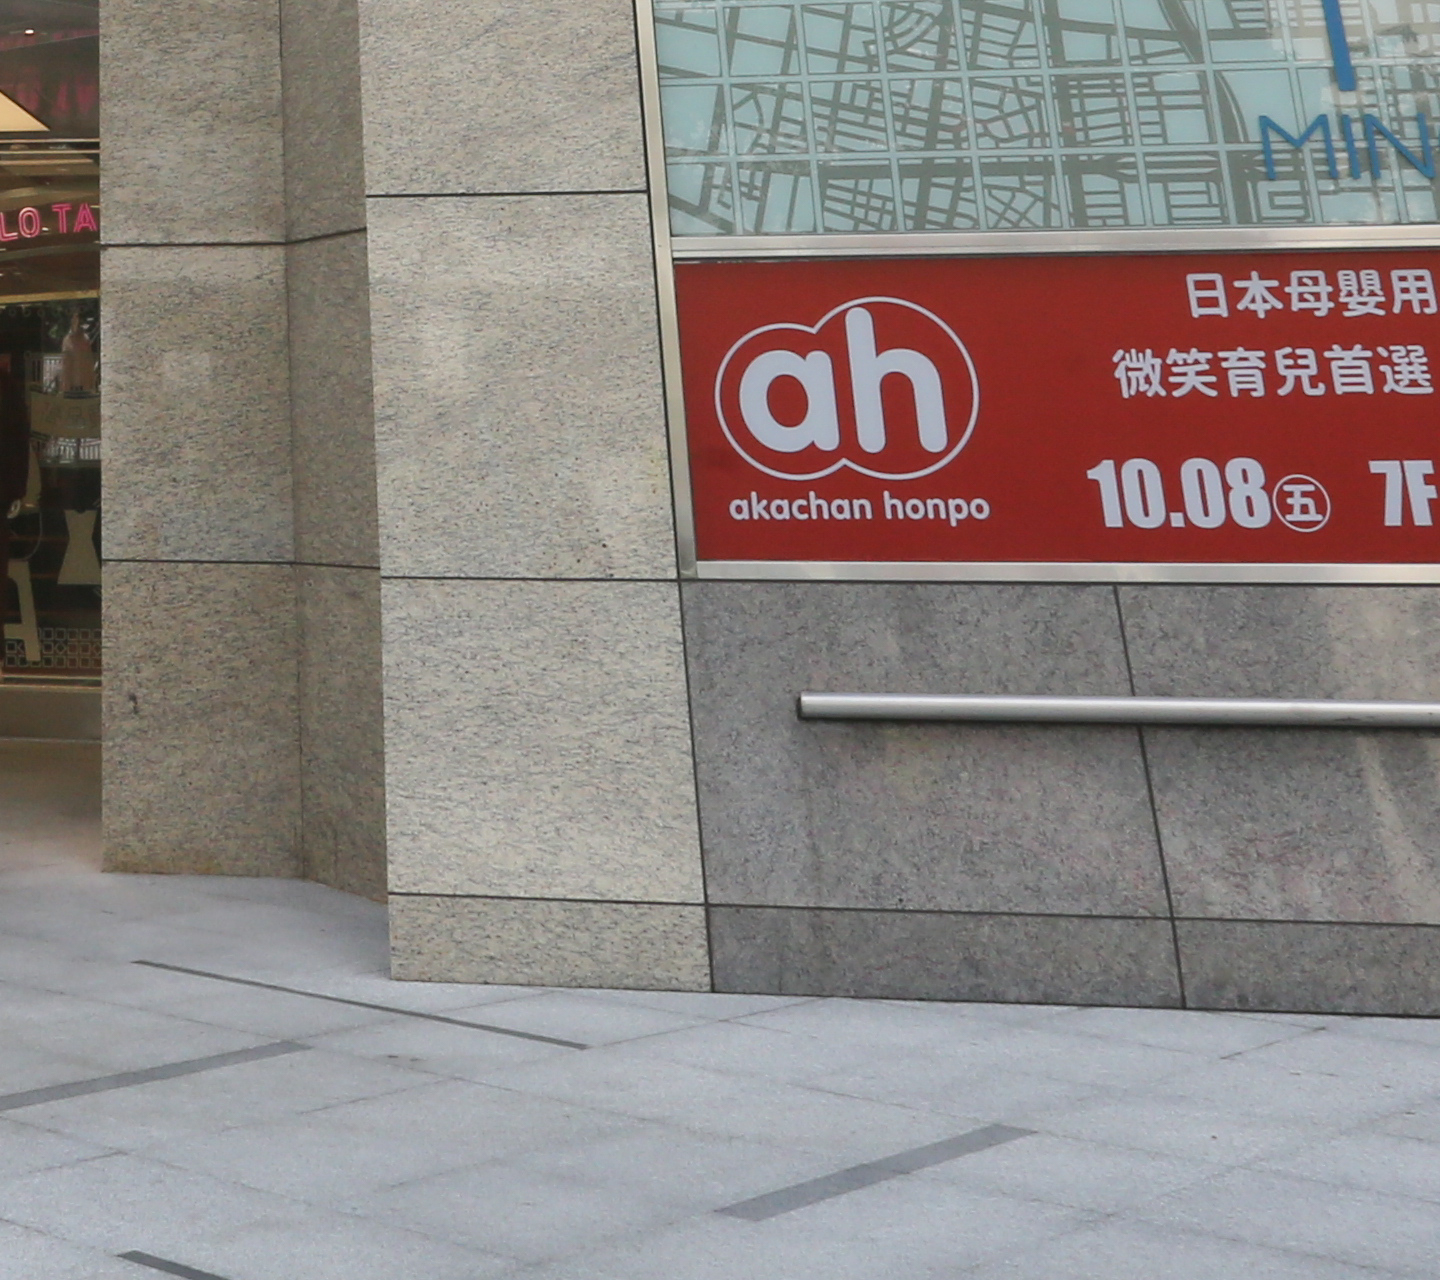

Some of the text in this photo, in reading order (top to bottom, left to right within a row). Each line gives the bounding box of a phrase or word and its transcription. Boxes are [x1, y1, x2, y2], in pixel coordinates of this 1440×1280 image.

[739, 307, 948, 456] ah
[1112, 343, 1434, 399] 微笑育兒首選
[729, 488, 991, 529] akachan honpo
[1087, 457, 1269, 529] 10.08
[1370, 458, 1439, 527] 7F
